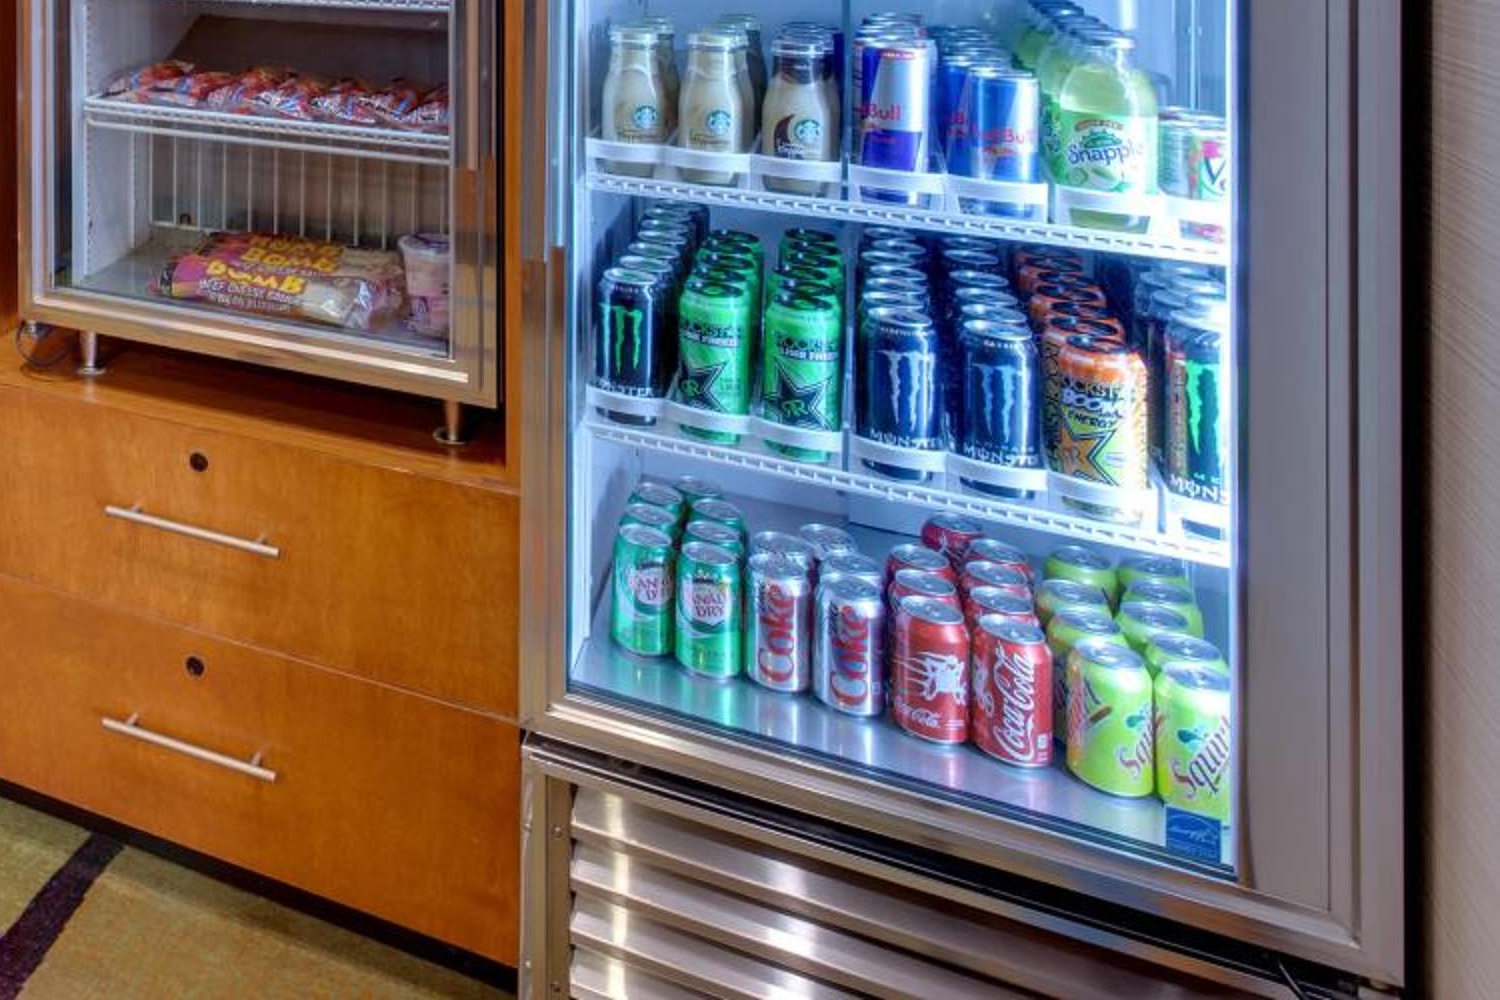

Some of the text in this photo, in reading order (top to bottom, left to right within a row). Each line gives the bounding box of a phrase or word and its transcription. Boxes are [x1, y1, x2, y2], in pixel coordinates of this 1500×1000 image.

[1171, 474, 1228, 503] MONS
[694, 604, 724, 618] DRY
[758, 583, 795, 682] Coke
[831, 604, 869, 706] Coke
[995, 648, 1036, 760] Coca-Cola
